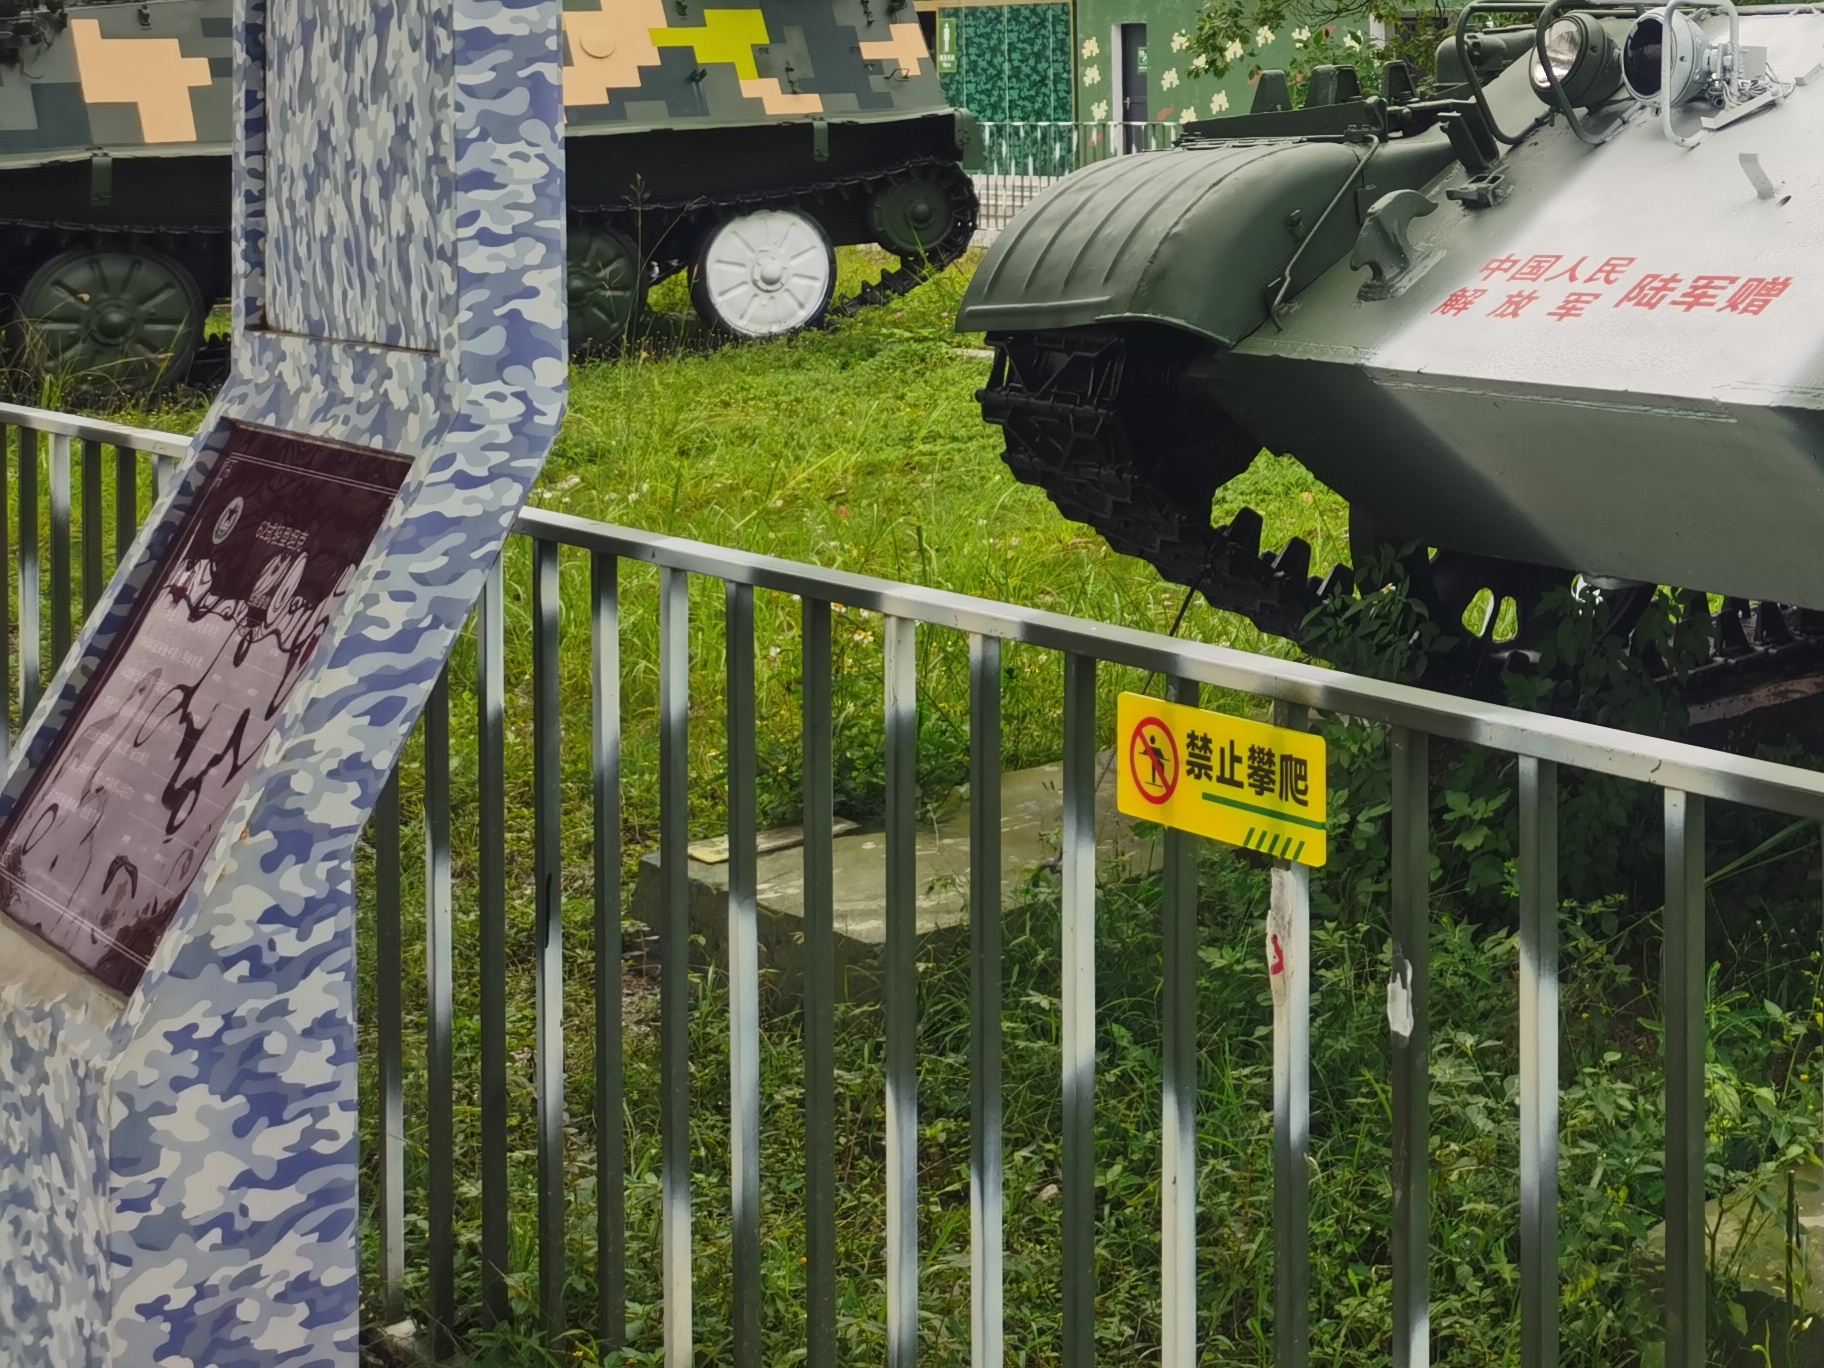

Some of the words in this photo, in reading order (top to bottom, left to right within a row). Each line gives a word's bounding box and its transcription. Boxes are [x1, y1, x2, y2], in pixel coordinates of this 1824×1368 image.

[1477, 253, 1638, 285] 中国人民
[1430, 286, 1605, 322] 解放军
[1613, 273, 1794, 316] 陆军赠
[1185, 729, 1309, 807] 禁止攀爬
